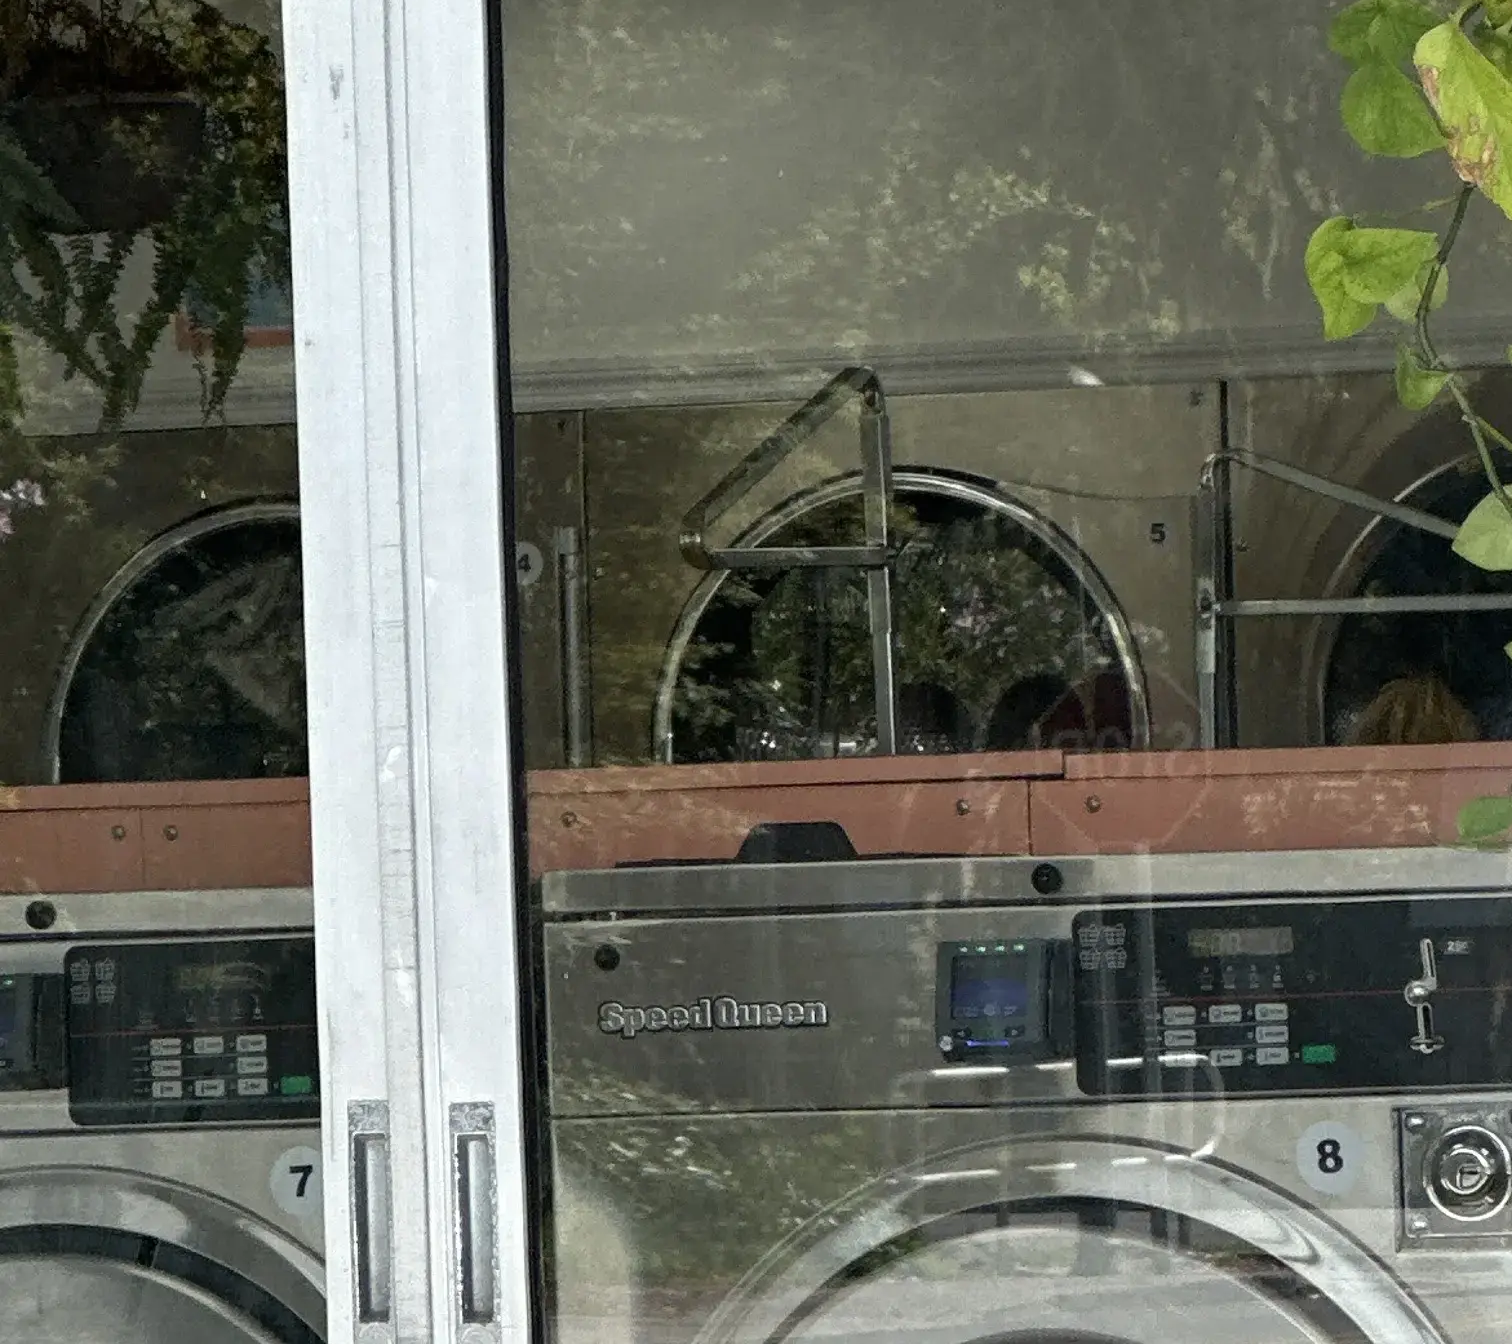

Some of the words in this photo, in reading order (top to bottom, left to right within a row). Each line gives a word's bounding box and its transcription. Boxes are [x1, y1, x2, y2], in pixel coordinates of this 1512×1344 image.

[1151, 522, 1166, 545] 5
[518, 554, 531, 573] 4
[599, 997, 713, 1039] Speed
[713, 996, 829, 1030] Queen
[1316, 1138, 1344, 1173] 8
[289, 1164, 313, 1197] 7
